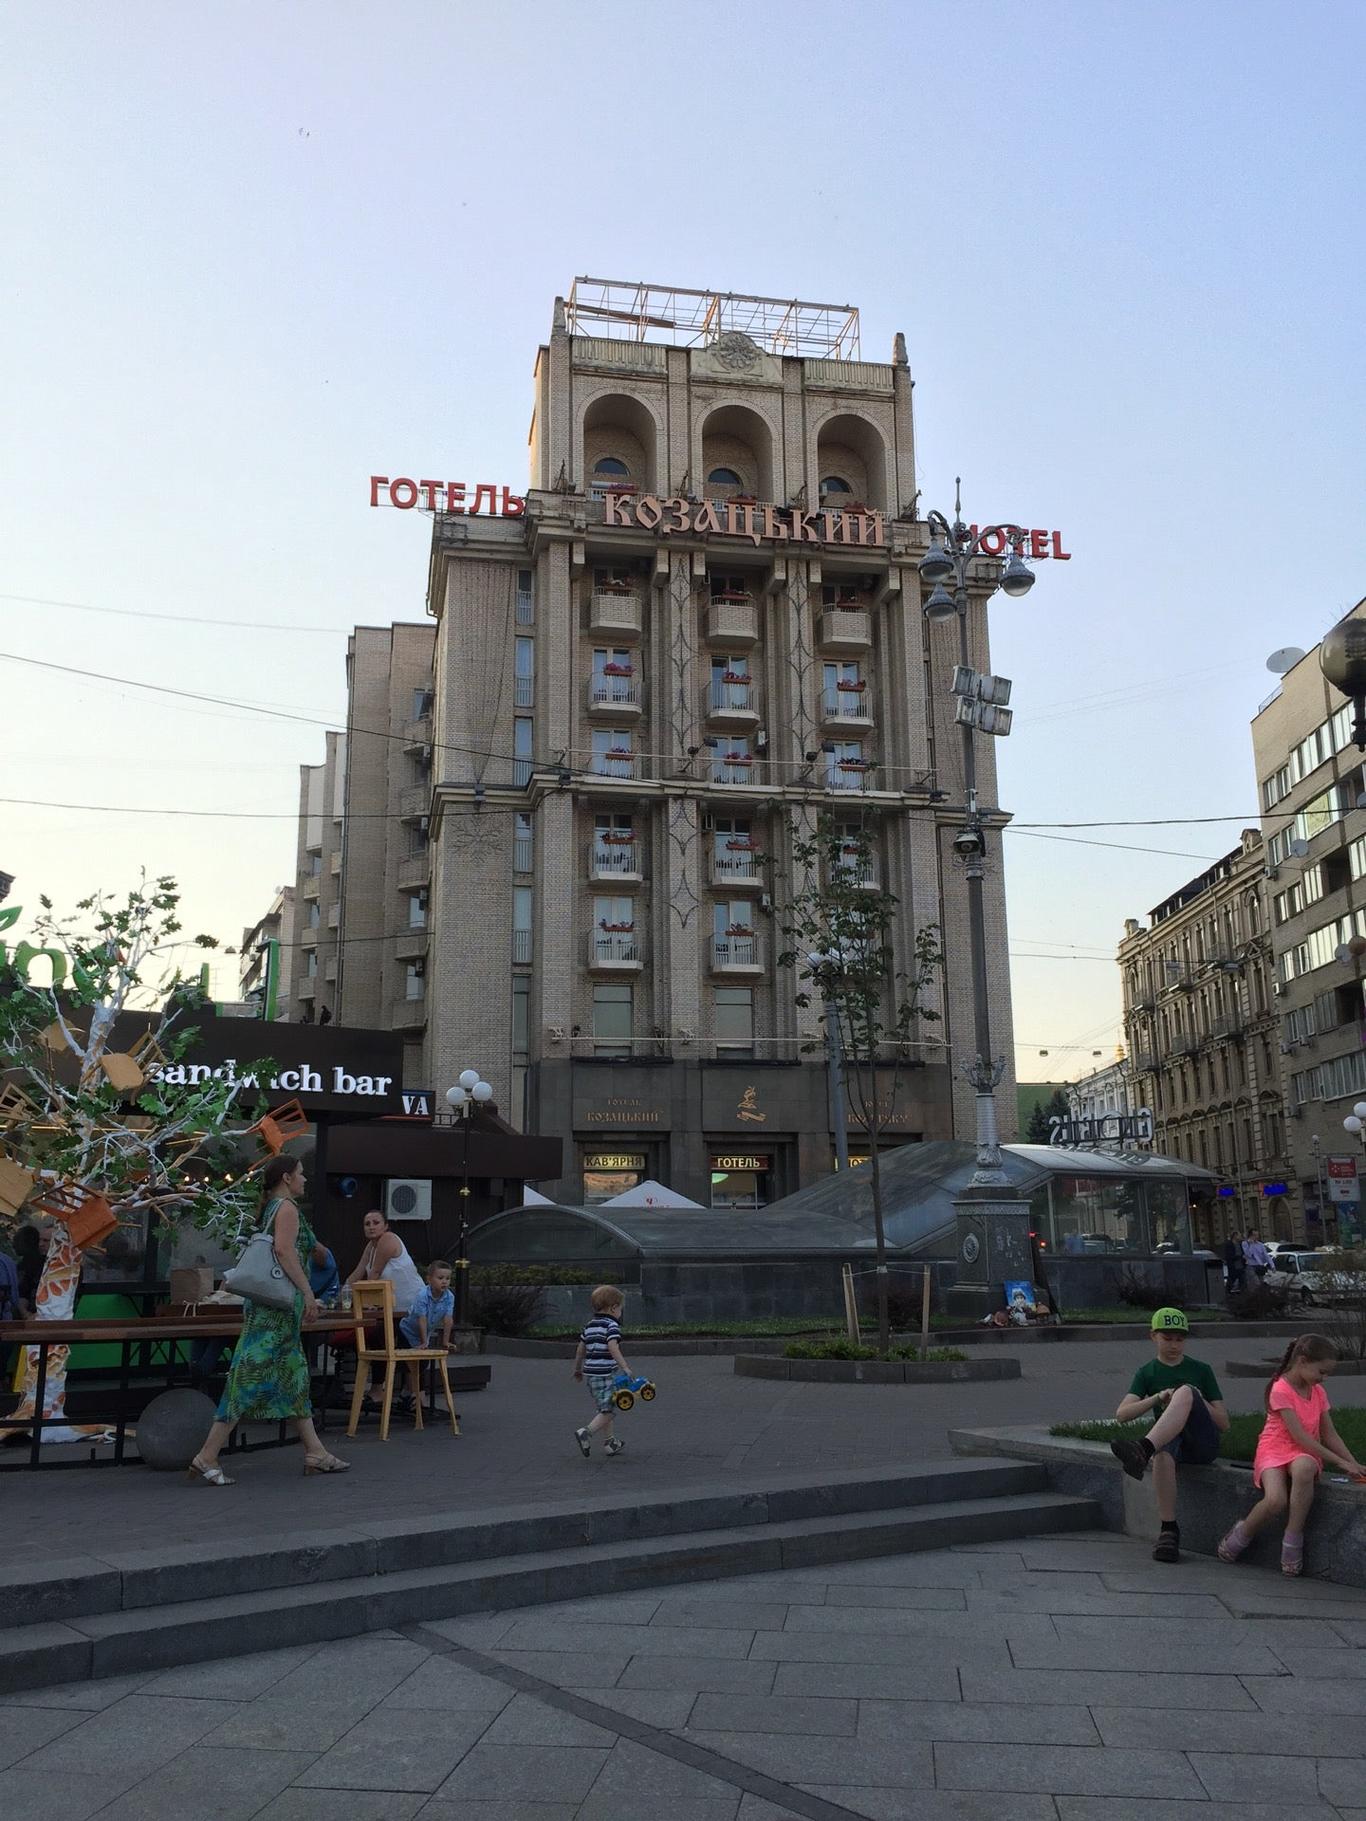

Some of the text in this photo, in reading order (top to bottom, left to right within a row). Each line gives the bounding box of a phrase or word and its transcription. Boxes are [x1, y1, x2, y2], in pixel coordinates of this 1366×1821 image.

[370, 475, 525, 517] ГОТЕЛЬ
[602, 492, 887, 547] КОЗАЦЬКИЙ
[331, 1066, 393, 1096] bar
[586, 1156, 642, 1167] КАВ'ЯРНЯ
[717, 1157, 760, 1168] ГОТЕЛЬ
[1163, 1315, 1186, 1327] BOY
